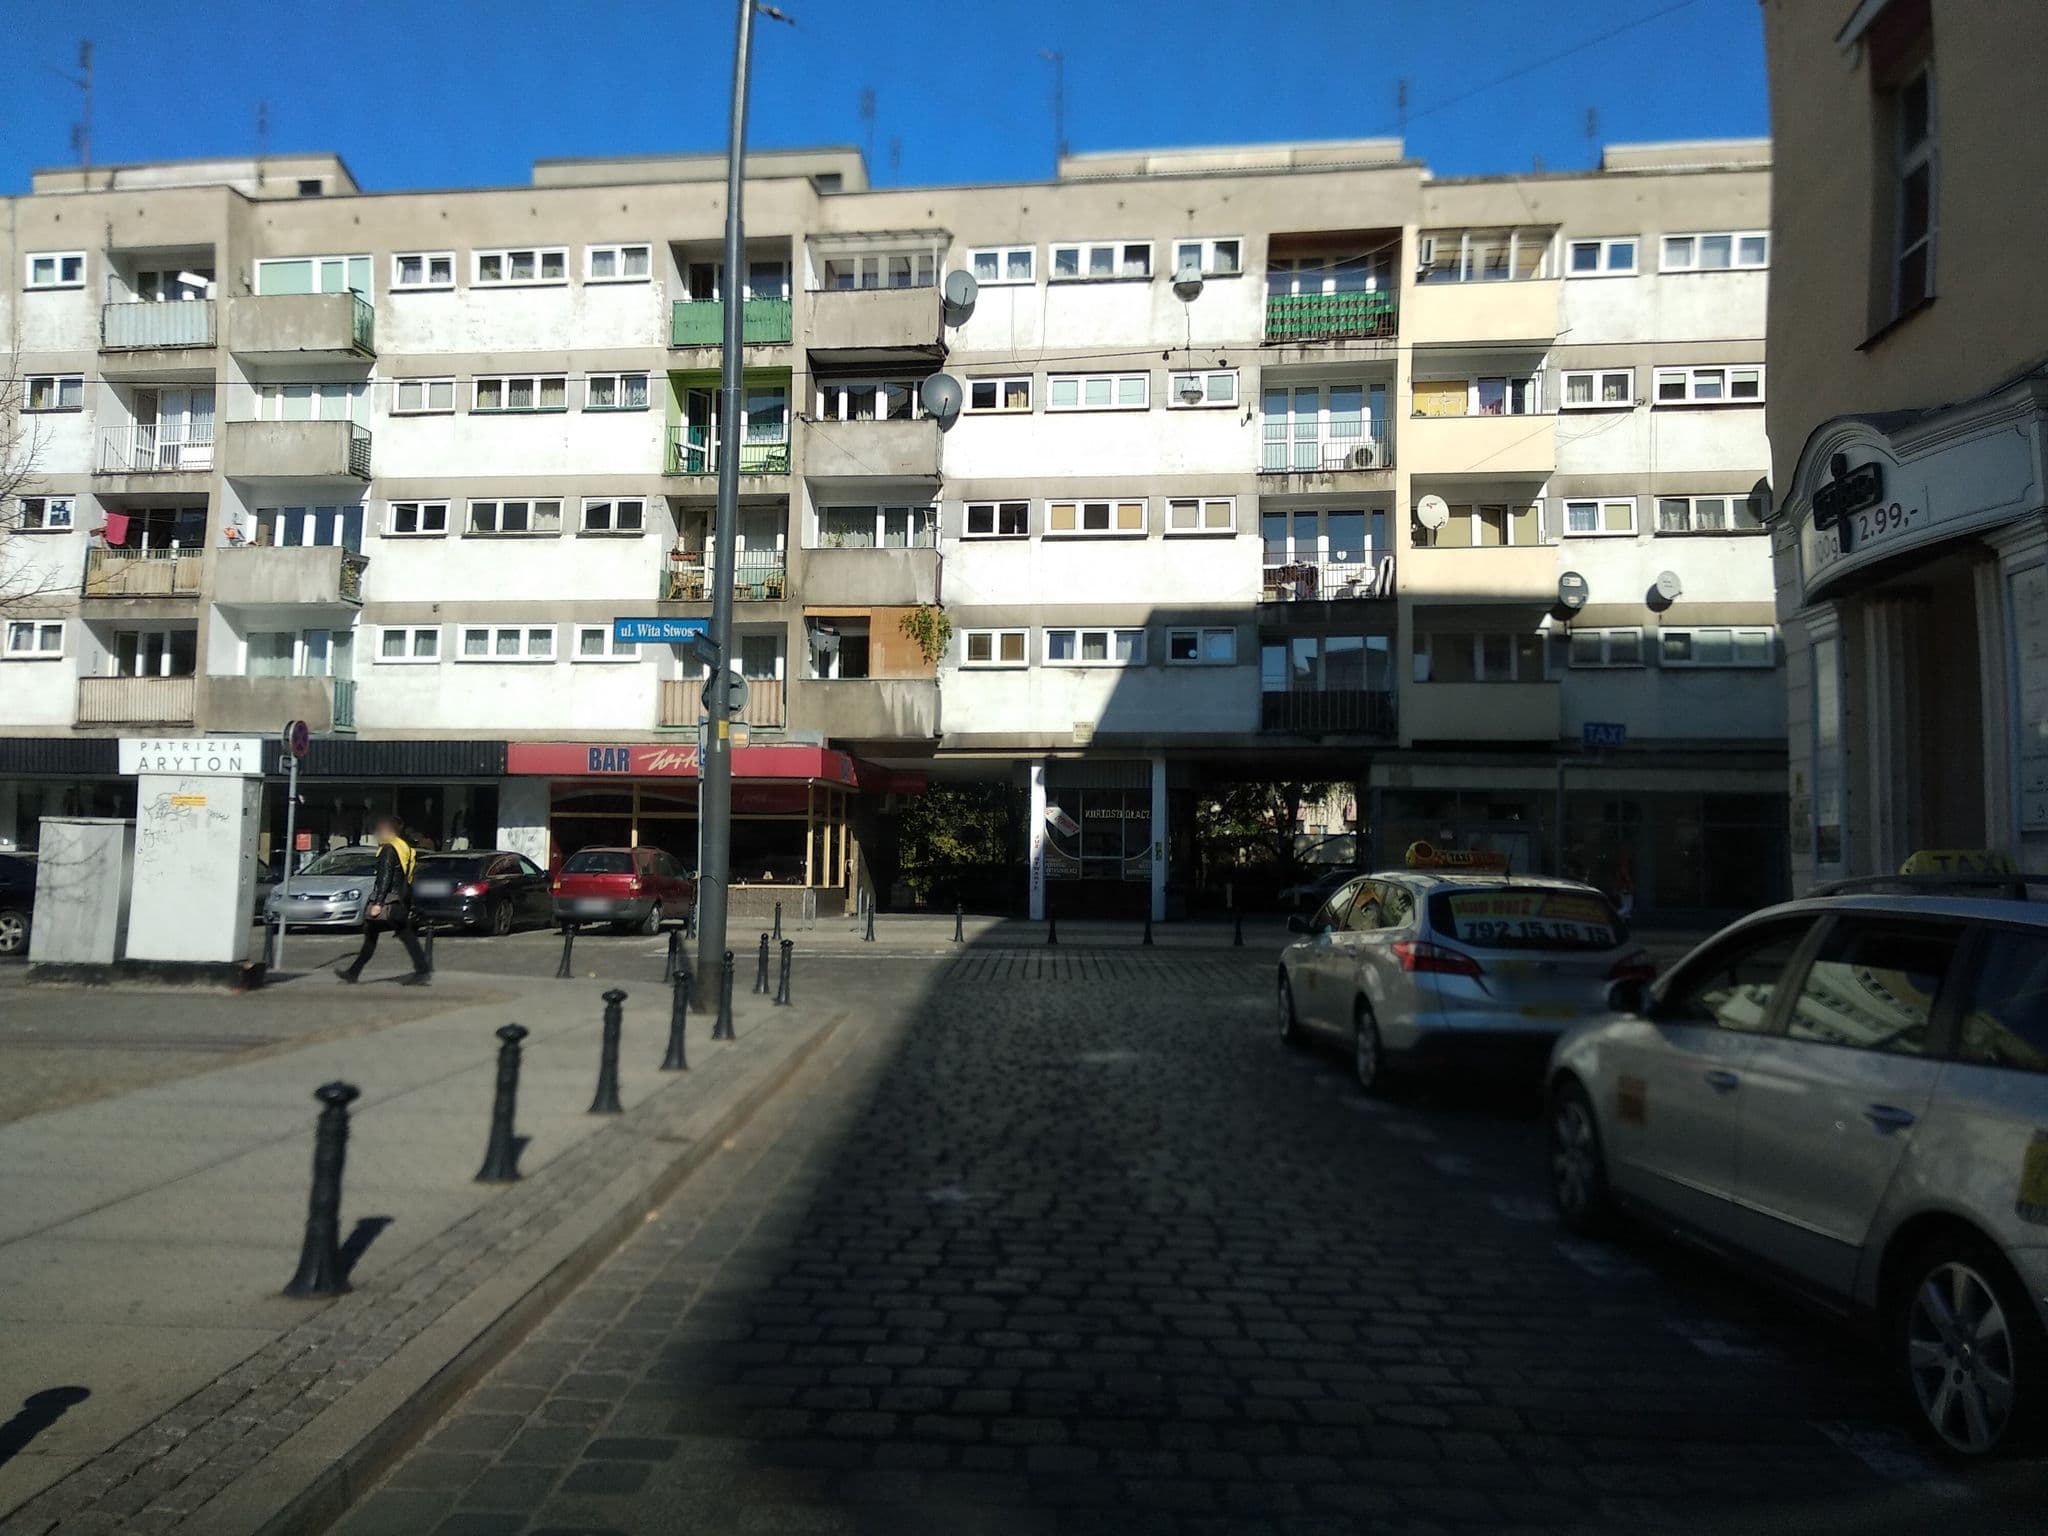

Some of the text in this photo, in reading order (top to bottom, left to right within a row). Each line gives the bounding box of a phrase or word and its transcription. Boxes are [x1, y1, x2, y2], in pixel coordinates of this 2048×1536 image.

[1859, 502, 1919, 541] 2.99,-
[621, 625, 634, 637] ul.
[637, 624, 660, 638] Wita
[1585, 726, 1624, 745] TAXI
[140, 742, 242, 752] PATRIZIA
[139, 757, 242, 772] ARYTON
[588, 747, 630, 772] BAR
[1450, 854, 1470, 863] TAXI
[1463, 920, 1610, 946] 792 15 15 15
